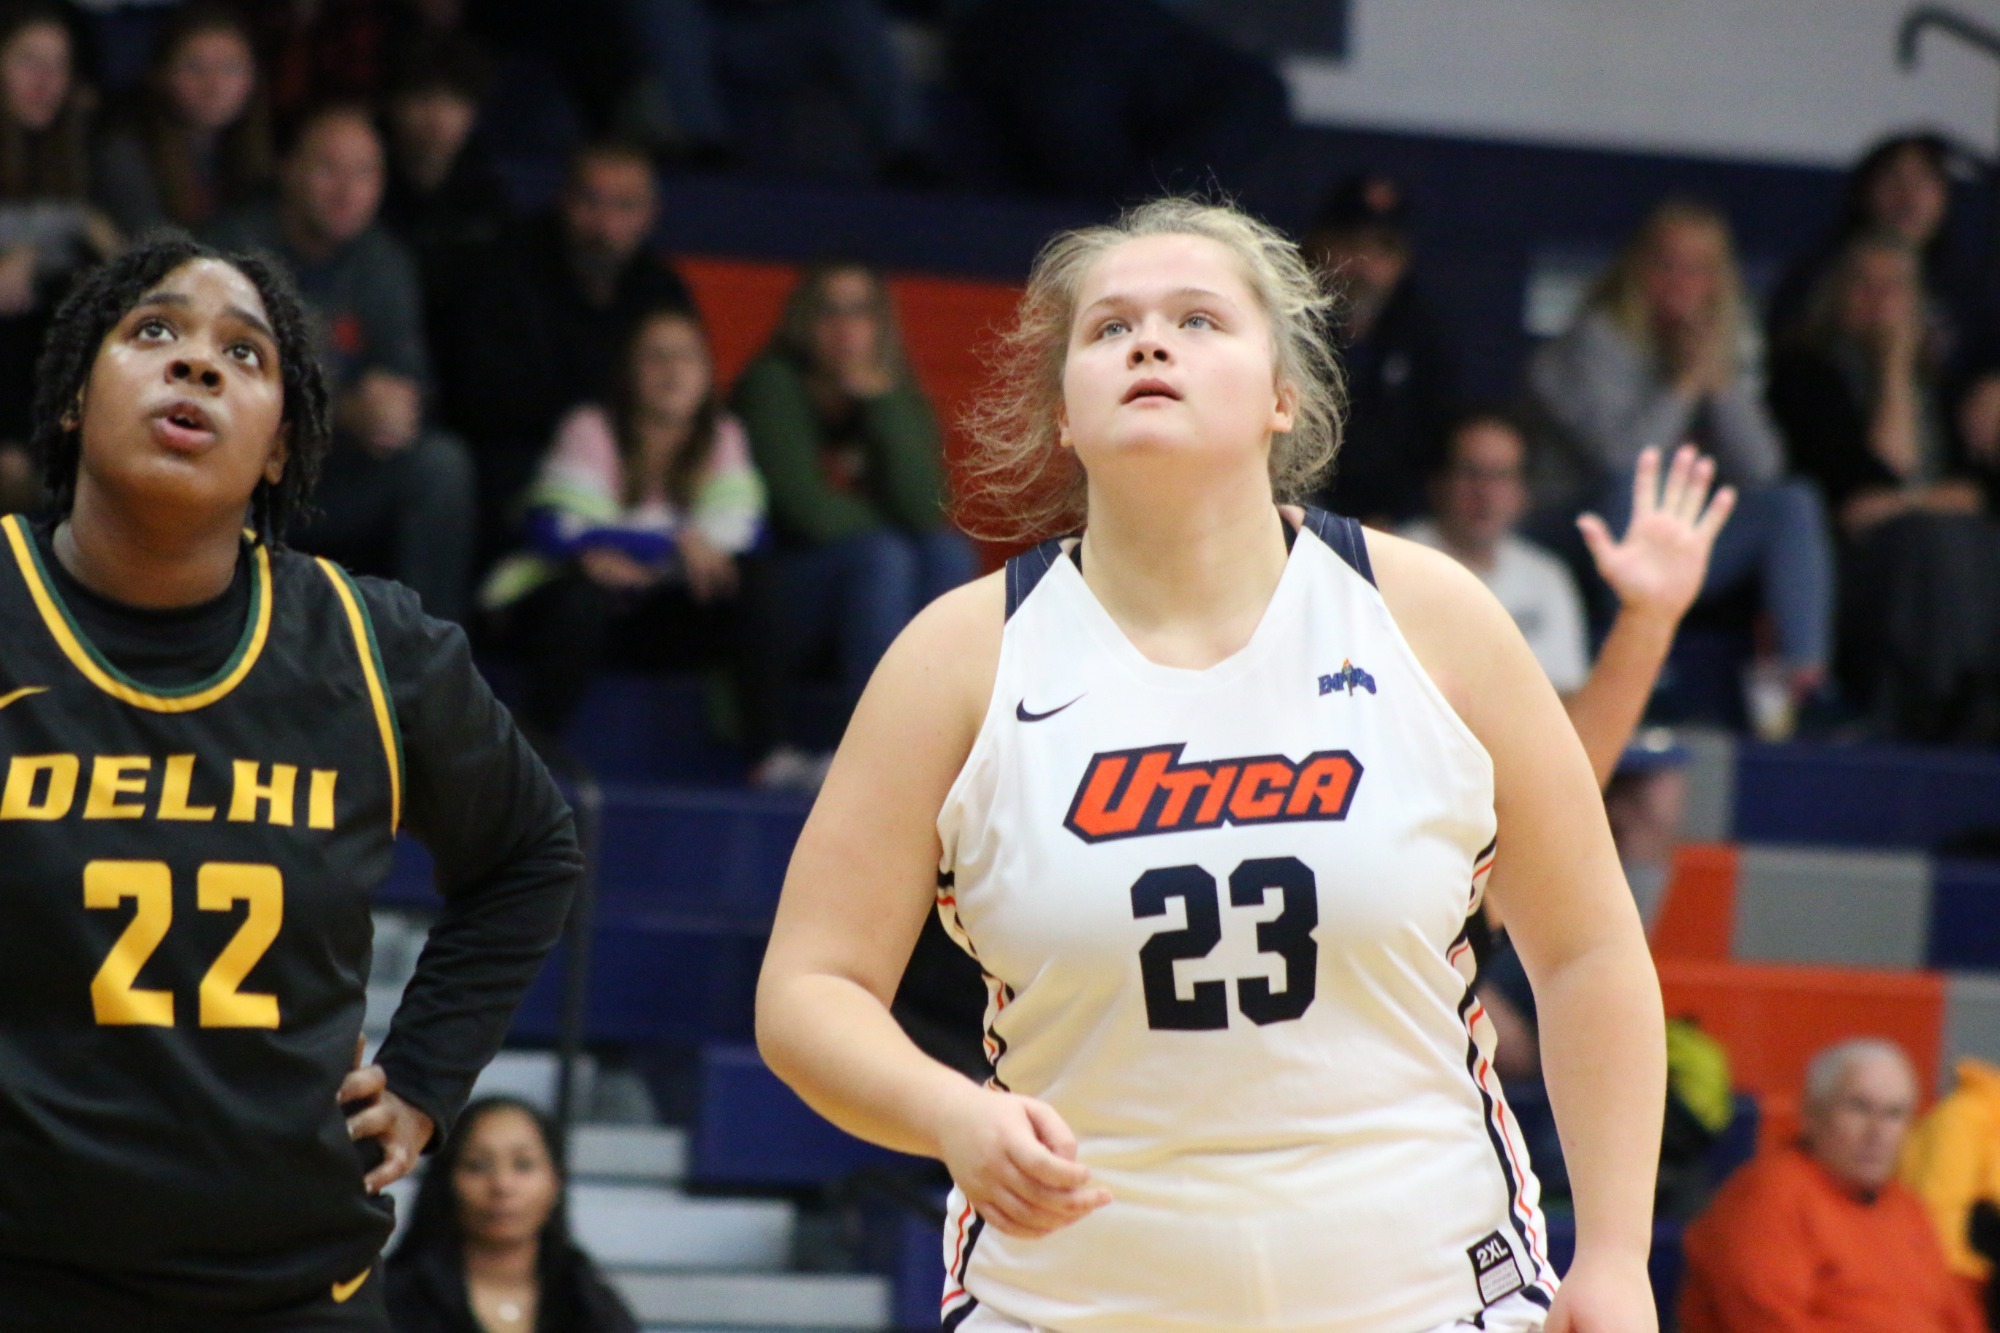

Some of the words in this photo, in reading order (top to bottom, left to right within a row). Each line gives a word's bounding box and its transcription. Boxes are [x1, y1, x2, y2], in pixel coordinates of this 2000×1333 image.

[0, 753, 338, 830] DELHI
[1063, 742, 1364, 844] UTICA
[83, 859, 284, 1029] 22
[1130, 856, 1319, 1031] 23
[1476, 1238, 1509, 1271] 2XL
